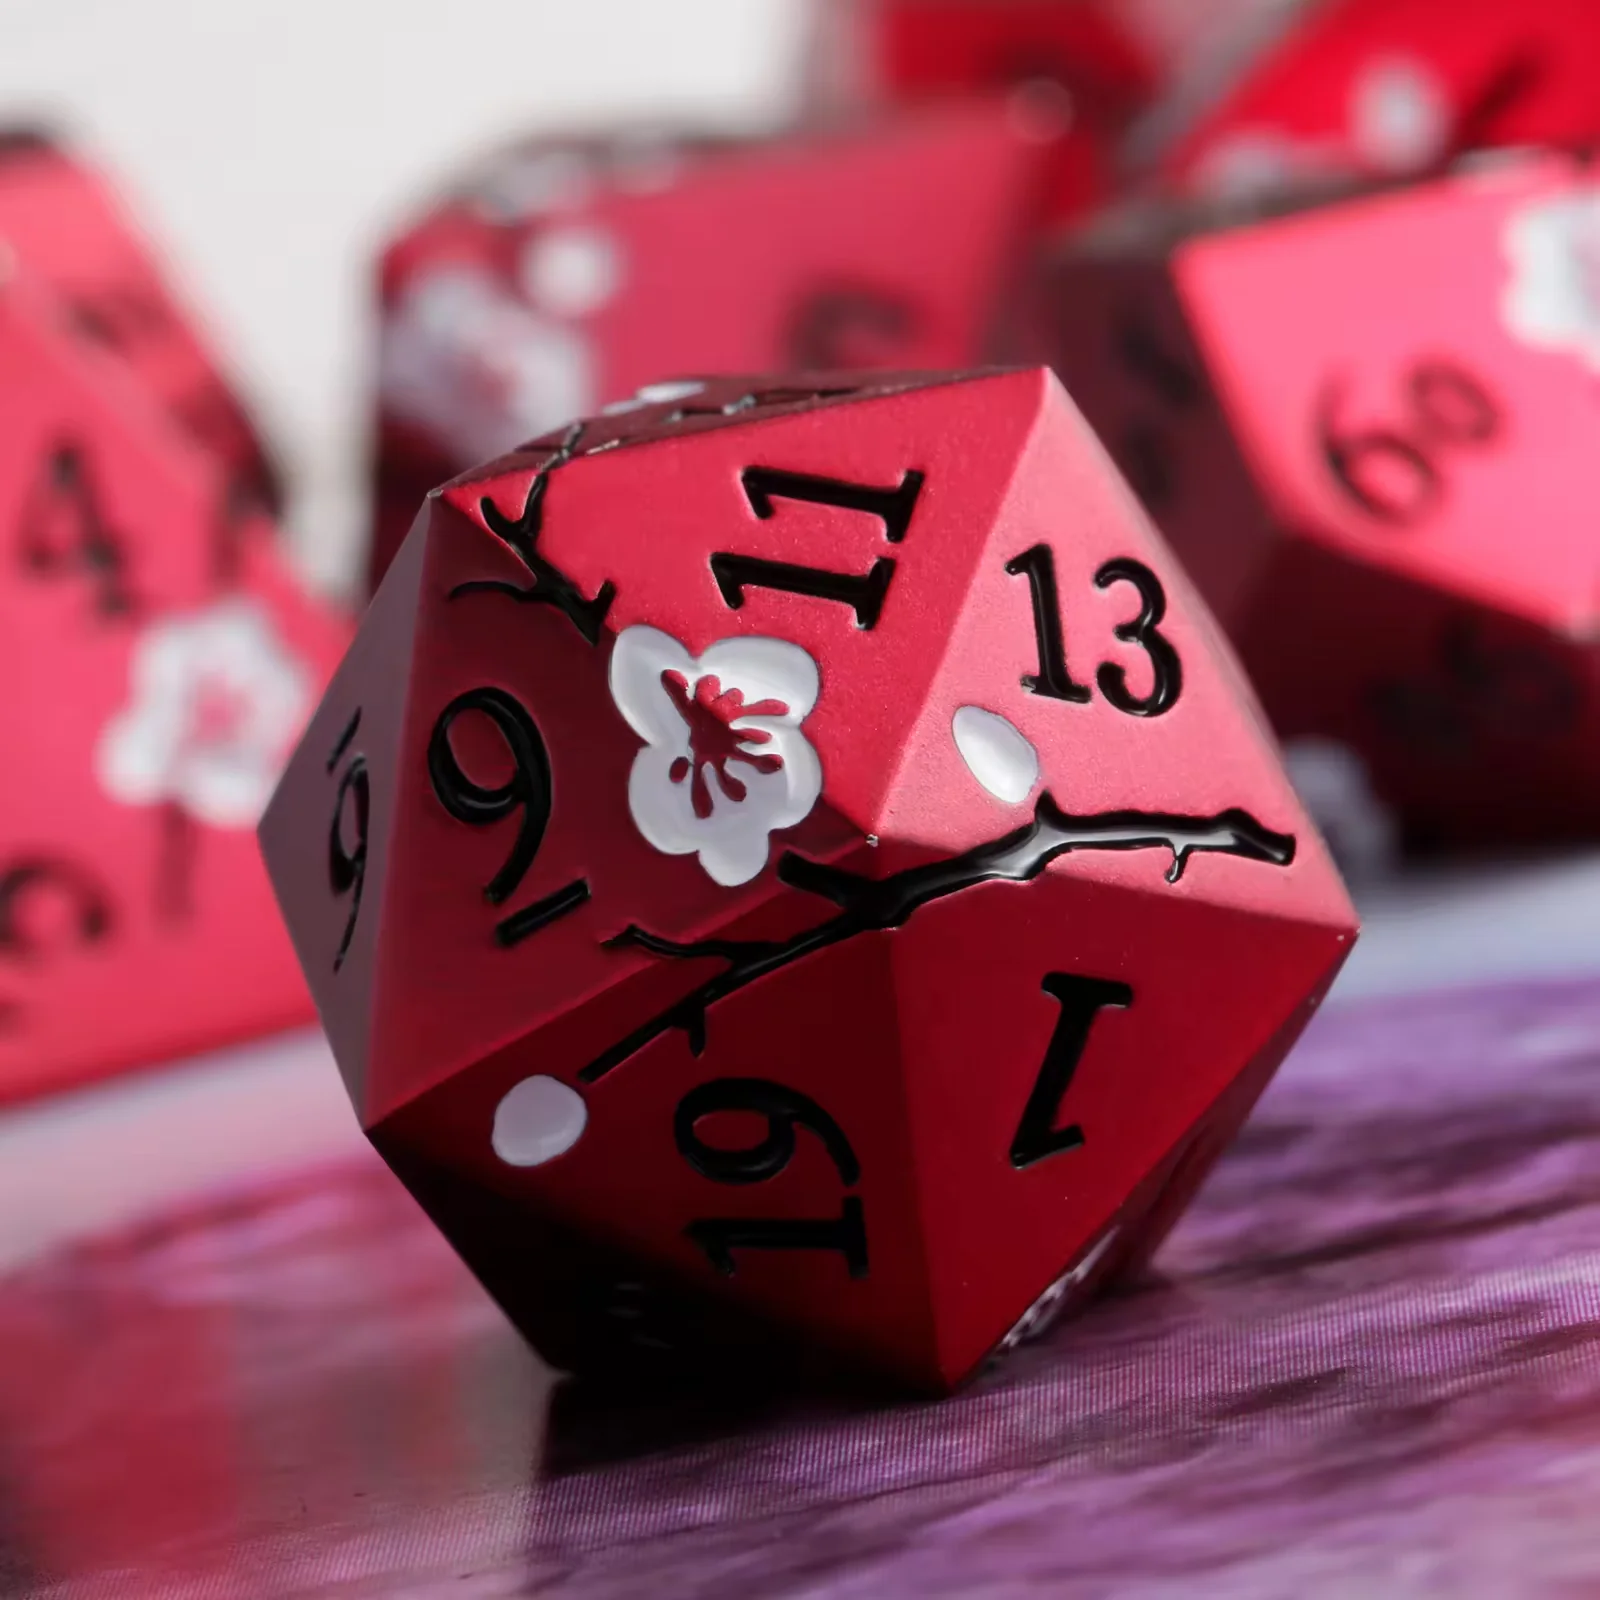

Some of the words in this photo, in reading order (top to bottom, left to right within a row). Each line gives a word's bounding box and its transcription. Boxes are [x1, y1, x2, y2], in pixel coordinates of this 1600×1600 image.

[709, 466, 925, 631] 11
[1004, 542, 1182, 718] 13
[1009, 971, 1133, 1170] 1
[674, 1077, 870, 1280] 19
